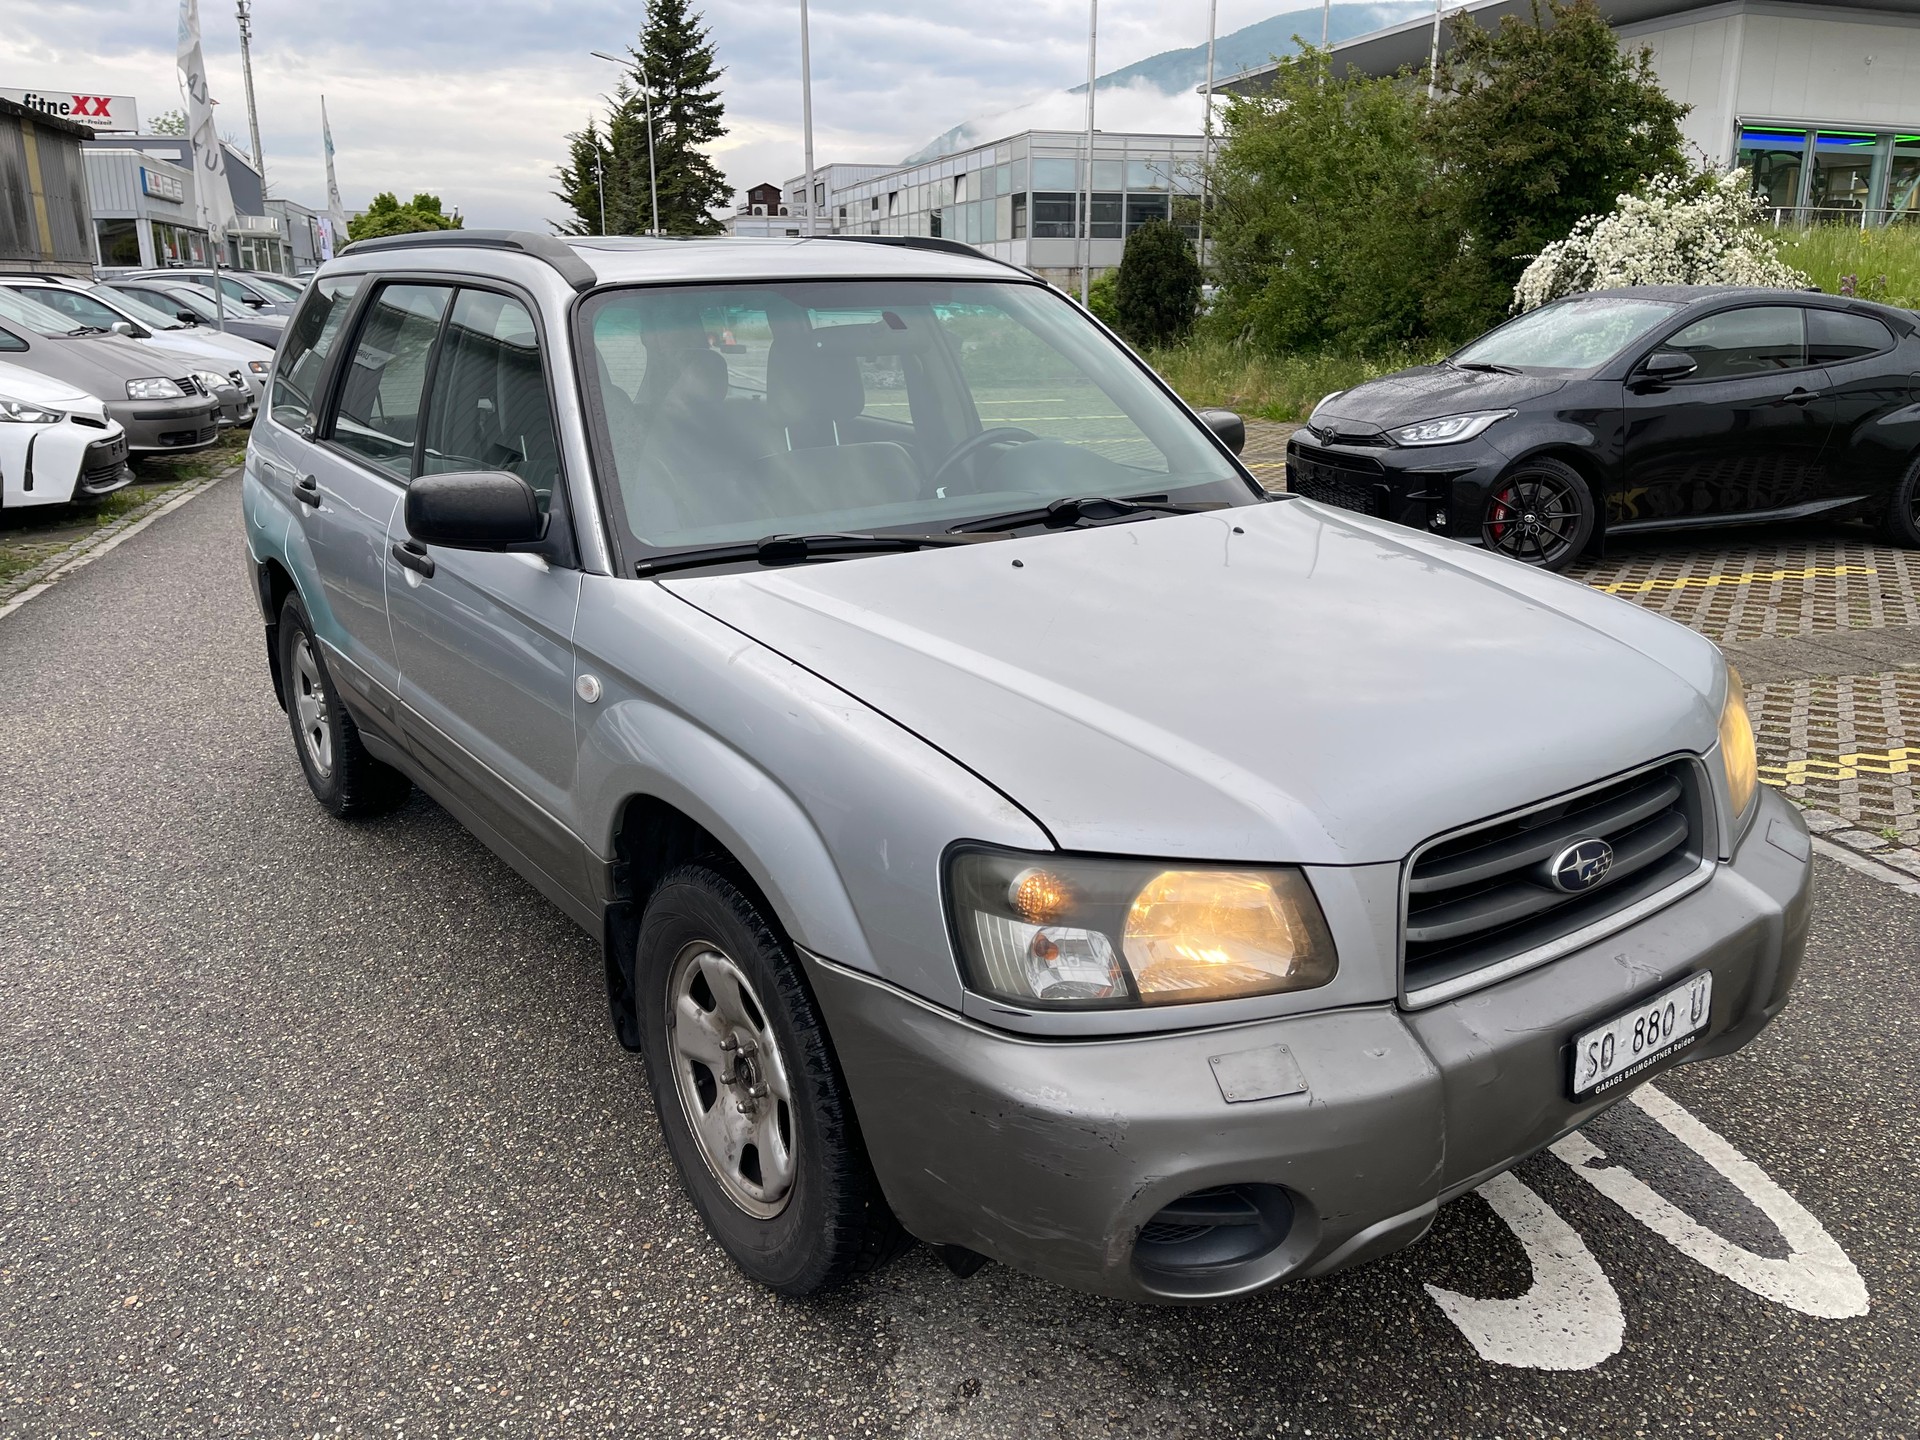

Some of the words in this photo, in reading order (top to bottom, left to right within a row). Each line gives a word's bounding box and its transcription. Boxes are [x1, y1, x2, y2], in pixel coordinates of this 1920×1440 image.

[23, 93, 112, 117] fitneXX
[1584, 1032, 1615, 1081] SO
[1631, 1001, 1675, 1053] 880
[1690, 983, 1705, 1024] U
[1595, 1074, 1623, 1094] GARAGE
[1625, 1047, 1672, 1078] BAUMGARTNER
